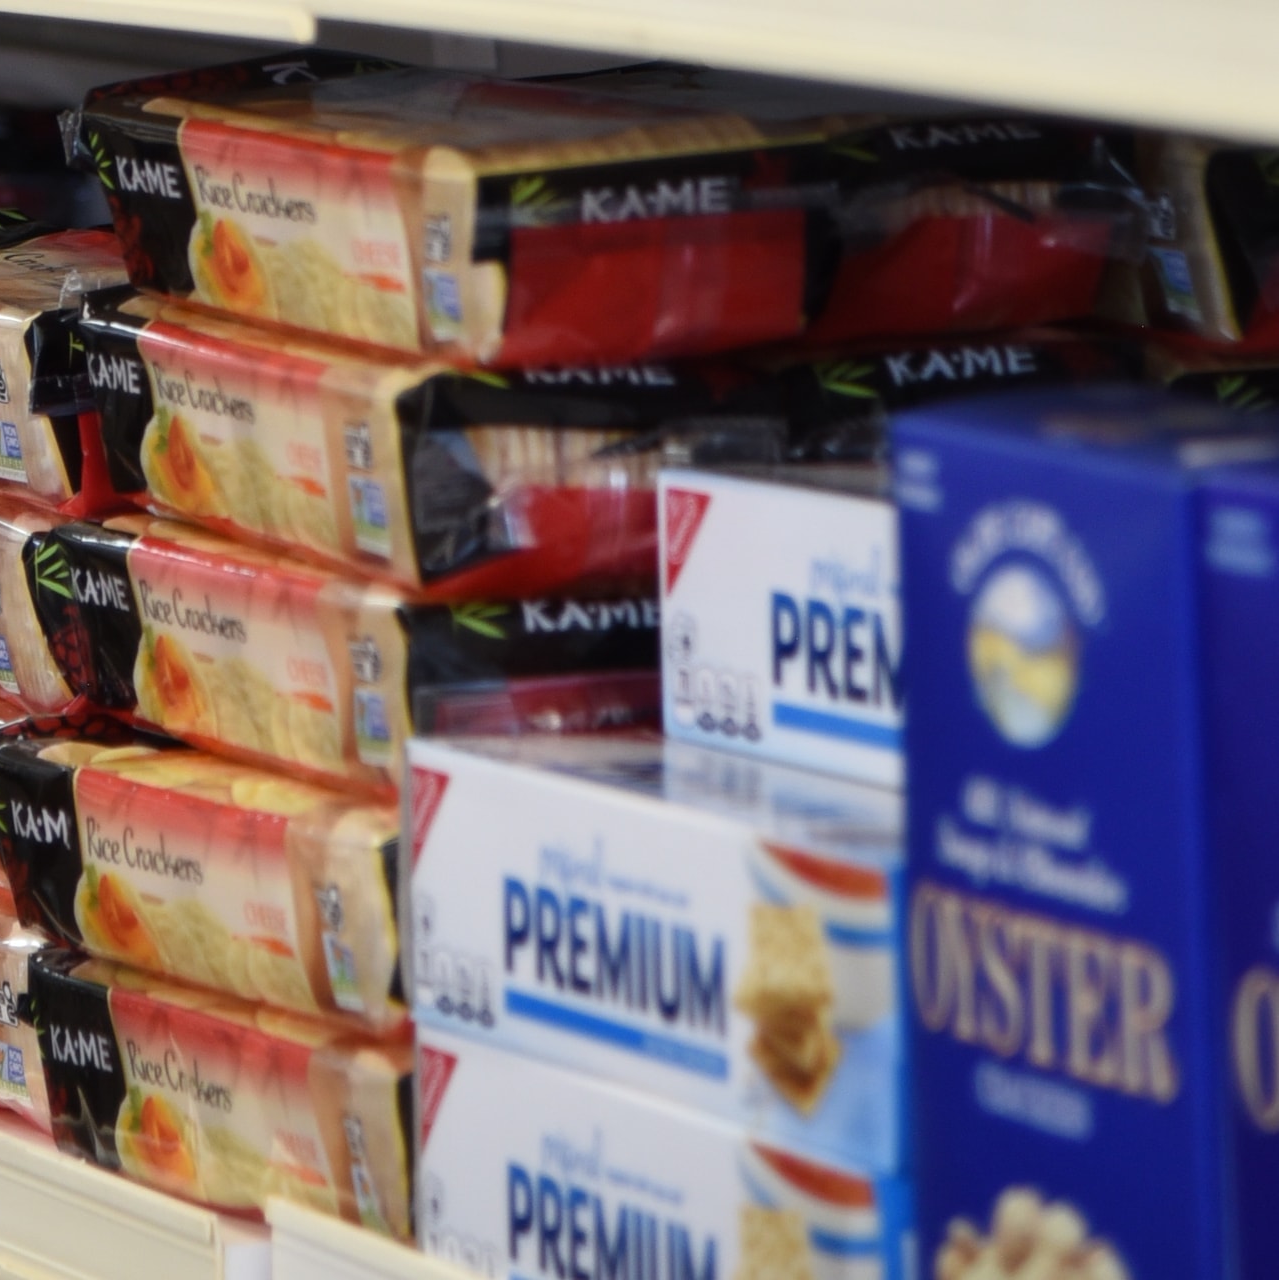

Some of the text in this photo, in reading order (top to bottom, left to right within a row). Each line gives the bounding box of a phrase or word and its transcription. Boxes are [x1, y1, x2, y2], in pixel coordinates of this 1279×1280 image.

[195, 164, 316, 224] Rice Crackers
[139, 579, 248, 645] Rice Crackers
[770, 590, 903, 711] PREM
[85, 816, 205, 886] Rice Crackers
[501, 875, 730, 1035] PREMIUM
[126, 1040, 164, 1086] Rice
